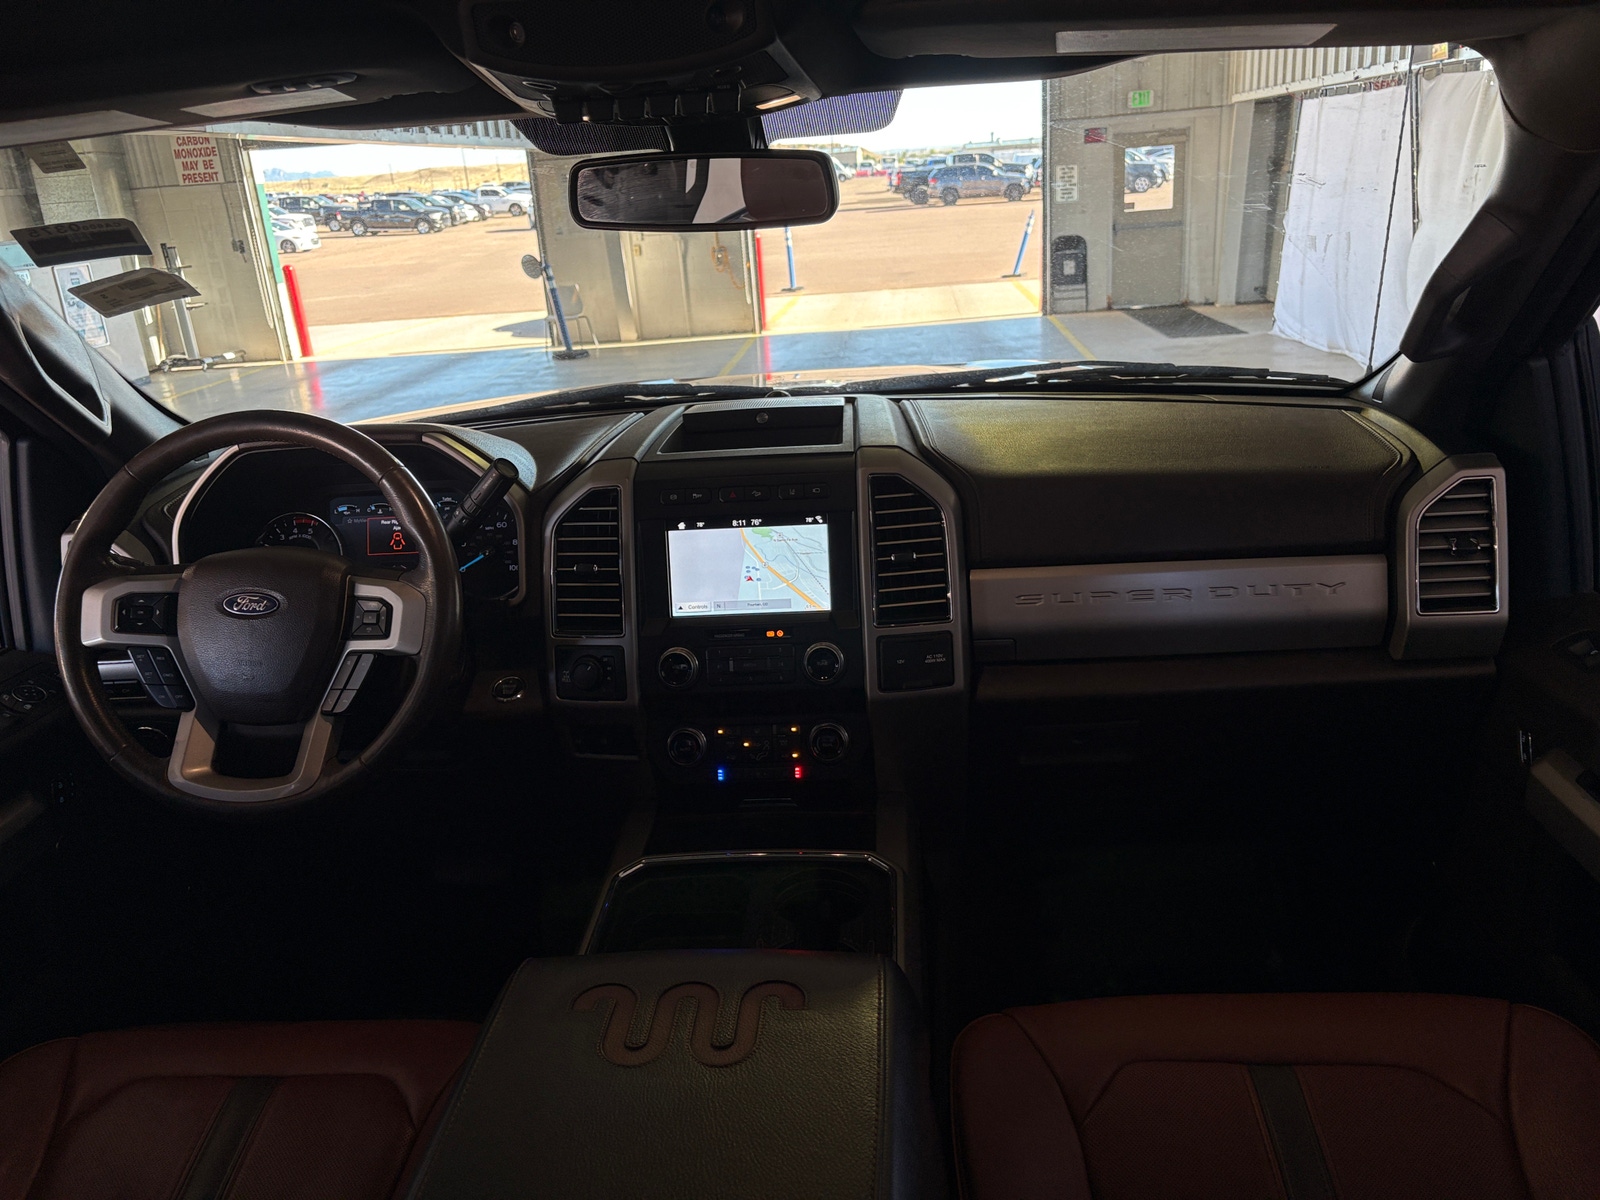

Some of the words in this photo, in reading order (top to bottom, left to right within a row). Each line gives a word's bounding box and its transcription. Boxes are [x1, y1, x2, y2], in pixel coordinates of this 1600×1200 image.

[1132, 90, 1150, 108] EXIT
[176, 136, 210, 147] CARBON
[173, 146, 218, 160] MONOXIDE
[181, 160, 199, 171] MAY
[202, 159, 215, 170] BE
[181, 171, 219, 184] PRESENT
[496, 521, 508, 529] 60
[732, 519, 746, 527] 8:11
[1015, 588, 1193, 606] SUPER
[1208, 581, 1346, 600] DUTY
[233, 595, 267, 611] Ford
